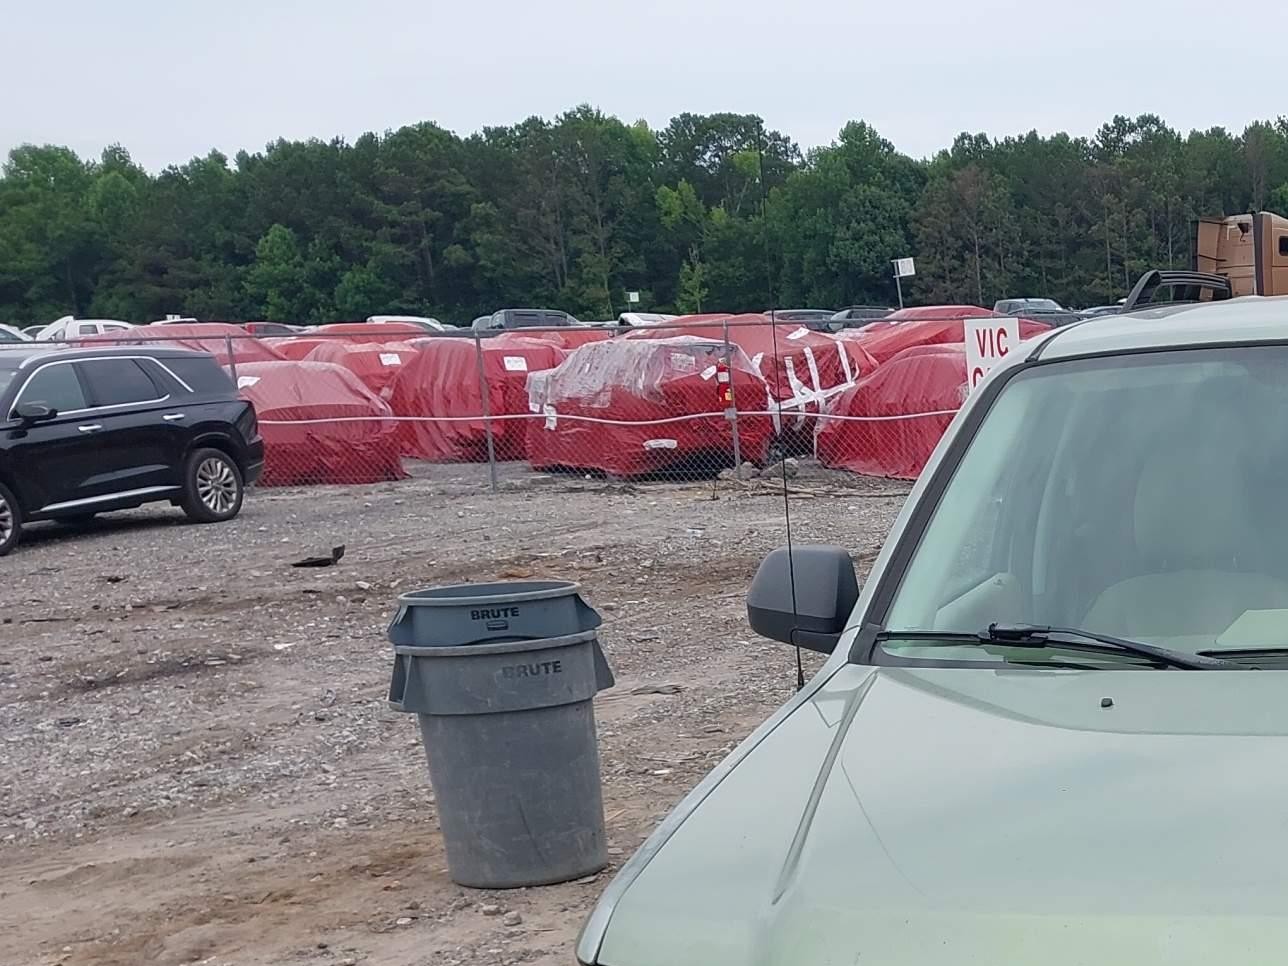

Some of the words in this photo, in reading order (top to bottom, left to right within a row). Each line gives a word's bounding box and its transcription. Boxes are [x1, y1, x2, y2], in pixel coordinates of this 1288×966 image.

[976, 327, 1009, 358] VIC
[470, 607, 520, 621] BRUTE
[501, 661, 562, 679] BRUTE
